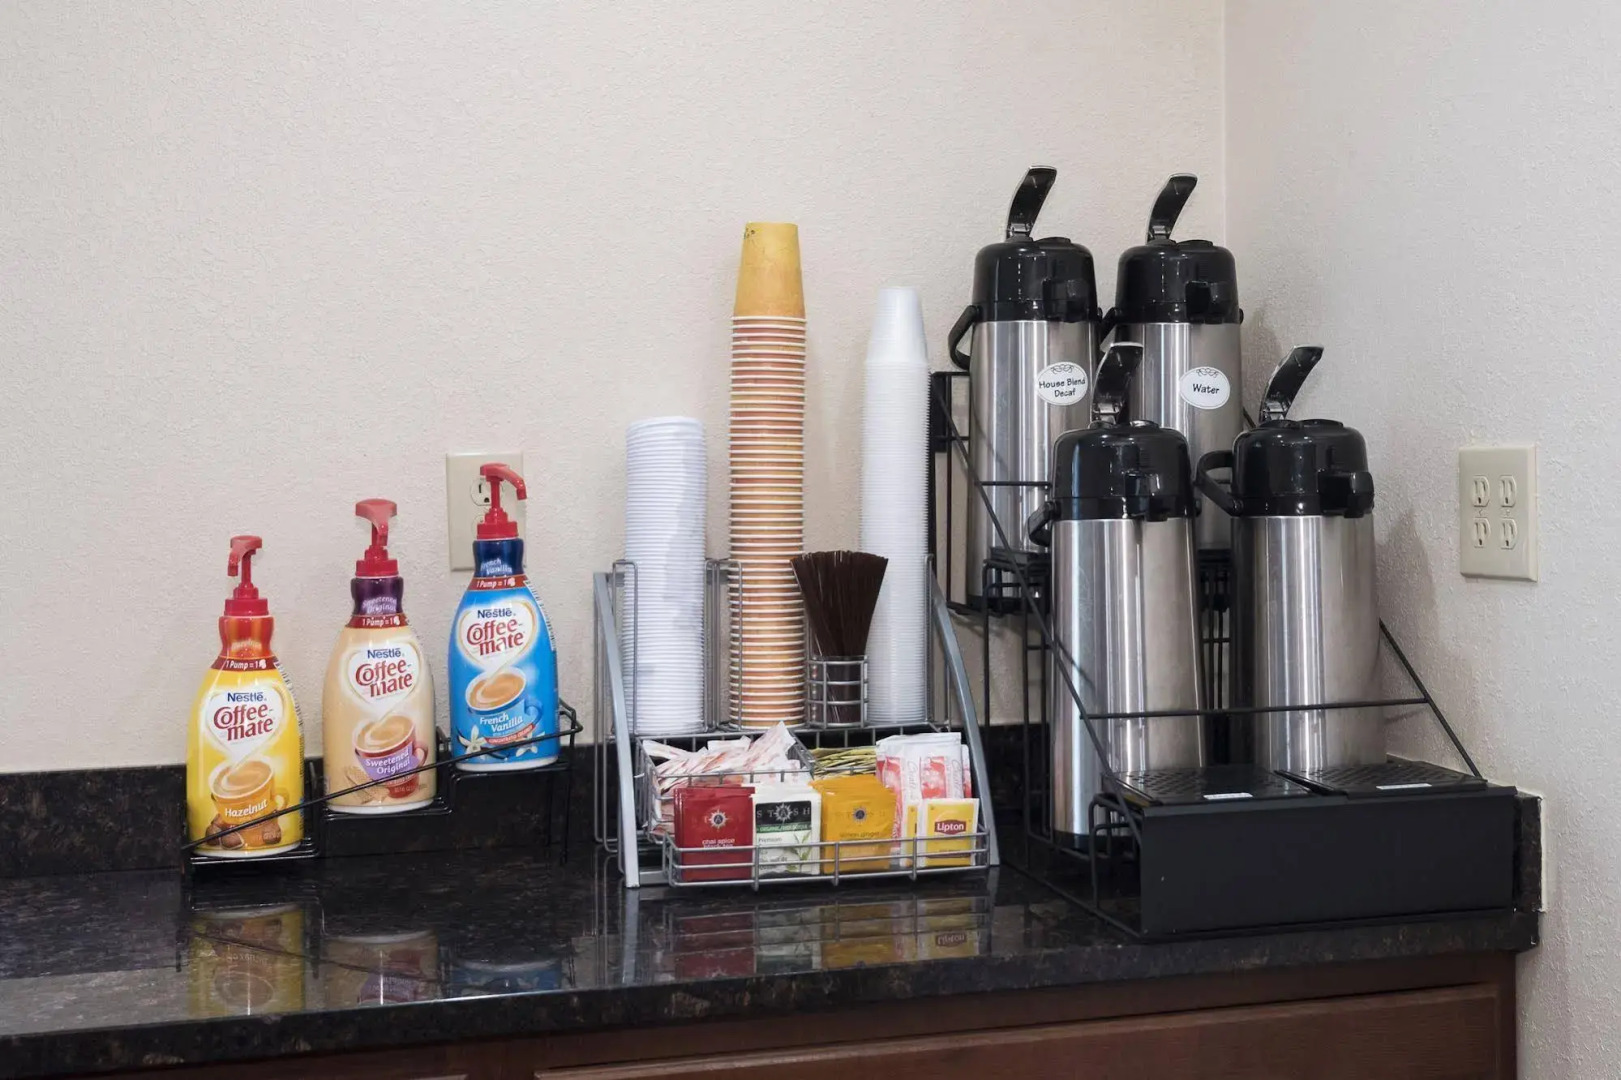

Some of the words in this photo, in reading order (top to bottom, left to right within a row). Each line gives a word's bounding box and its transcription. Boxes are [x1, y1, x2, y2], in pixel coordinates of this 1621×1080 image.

[1038, 379, 1065, 389] House
[1067, 377, 1086, 387] Blend
[1192, 383, 1220, 395] Water
[1054, 388, 1076, 398] Decaf
[480, 580, 497, 589] Pump
[366, 617, 383, 627] Pump
[479, 632, 524, 656] mate
[230, 660, 249, 670] Pump
[370, 673, 413, 698] mate
[480, 712, 509, 725] French
[491, 716, 523, 732] Vanilla
[227, 718, 274, 741] mate
[364, 747, 409, 767] Sweetened
[376, 757, 411, 775] Original
[224, 799, 268, 817] Hazelnut
[936, 823, 965, 833] Lipton
